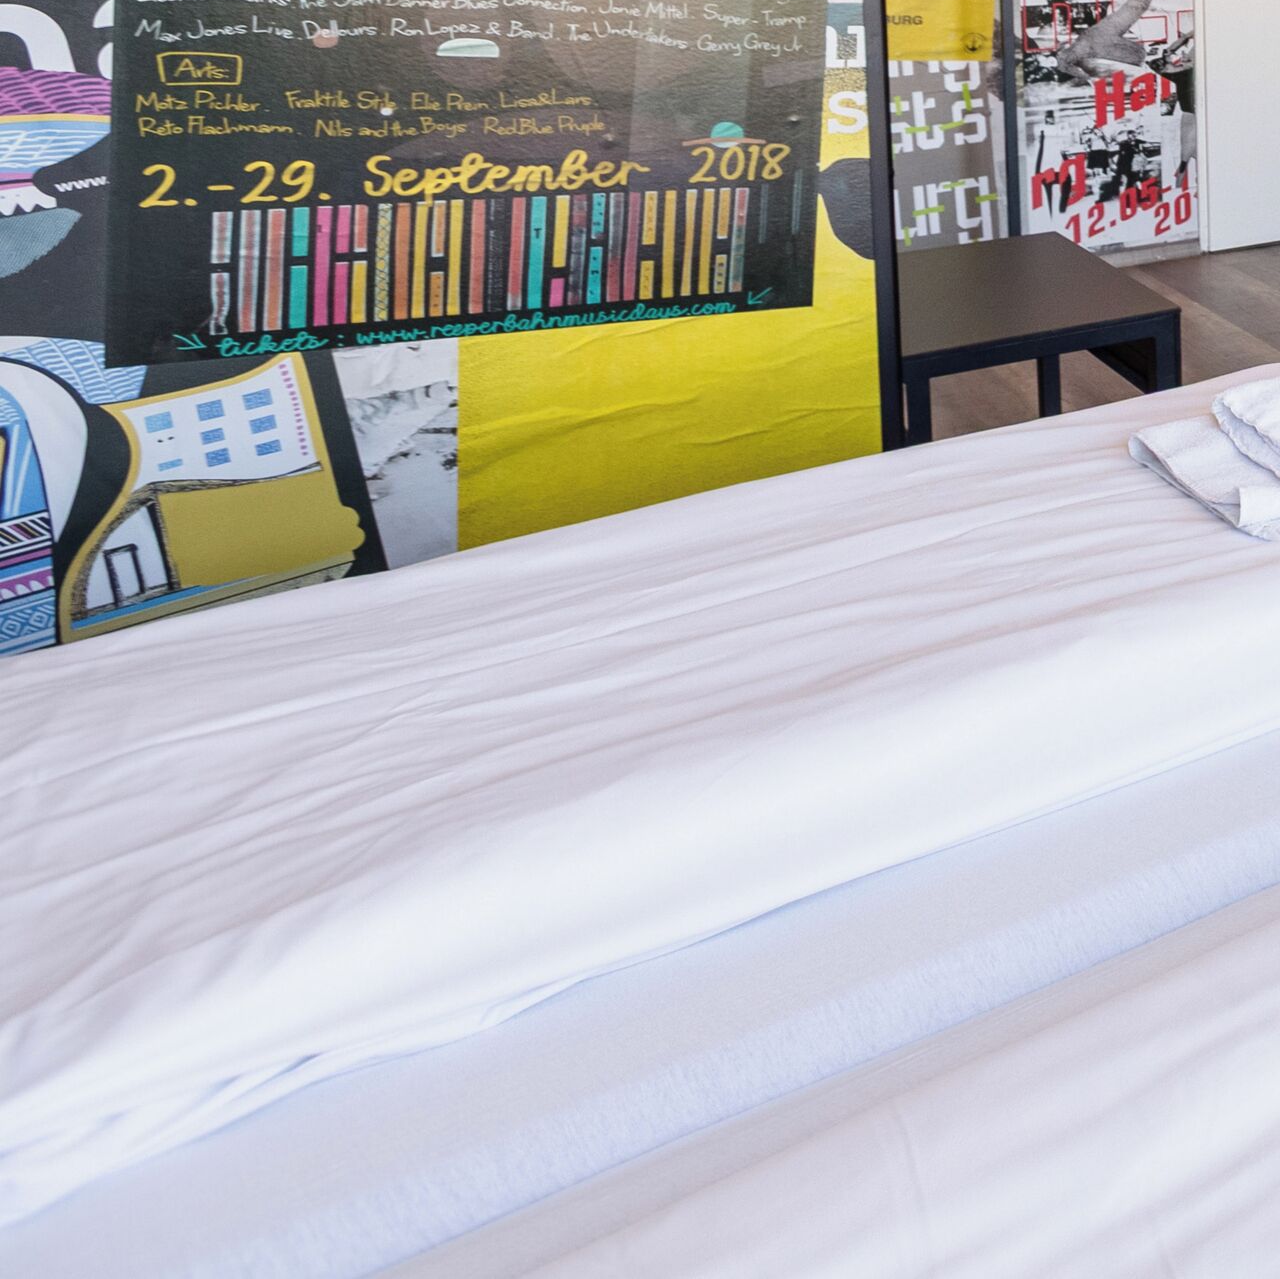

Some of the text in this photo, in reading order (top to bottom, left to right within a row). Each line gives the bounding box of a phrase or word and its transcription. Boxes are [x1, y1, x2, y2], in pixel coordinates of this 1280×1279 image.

[134, 19, 181, 43] Max
[187, 19, 248, 39] Jones
[425, 18, 480, 40] Lopez
[486, 22, 501, 36] &
[567, 24, 592, 41] The
[744, 33, 780, 57] Grey
[138, 116, 185, 138] Reto
[314, 118, 353, 138] Nils
[359, 120, 388, 138] and
[391, 120, 417, 137] the
[364, 149, 650, 207] September
[688, 143, 791, 184] 2018
